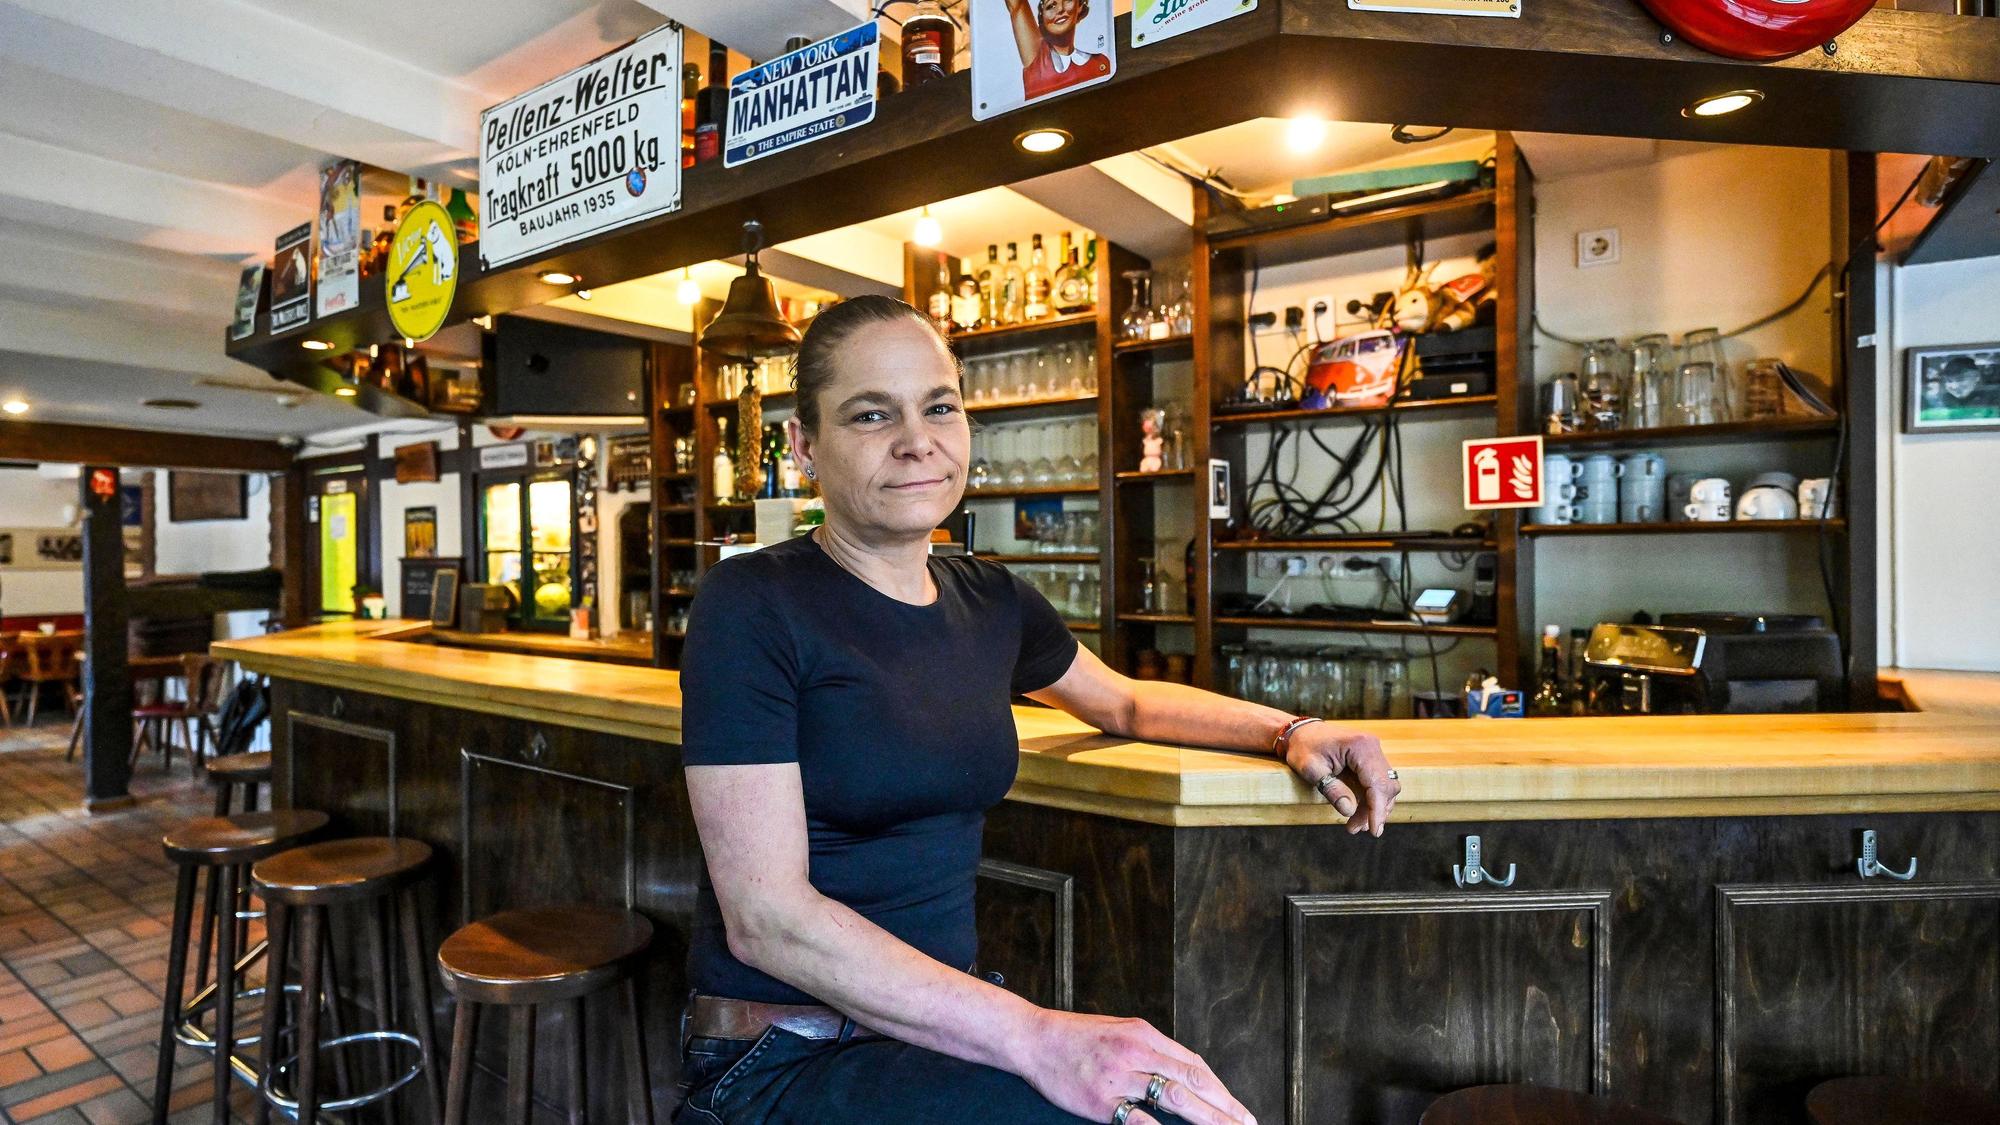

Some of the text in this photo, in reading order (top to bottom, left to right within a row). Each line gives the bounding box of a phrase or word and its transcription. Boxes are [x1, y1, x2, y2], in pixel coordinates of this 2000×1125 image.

[731, 51, 870, 137] MANHATTAN
[761, 38, 839, 86] NEW YORK
[486, 52, 667, 158] Pellenz-Welter
[496, 102, 640, 177] KÖLN-EHRENFELD
[757, 137, 774, 152] THE
[775, 127, 807, 145] EMPIRE
[808, 119, 836, 136] STATE
[487, 129, 659, 222] Tragkraft 5000 kg
[519, 190, 616, 236] BAUJAHR 1935
